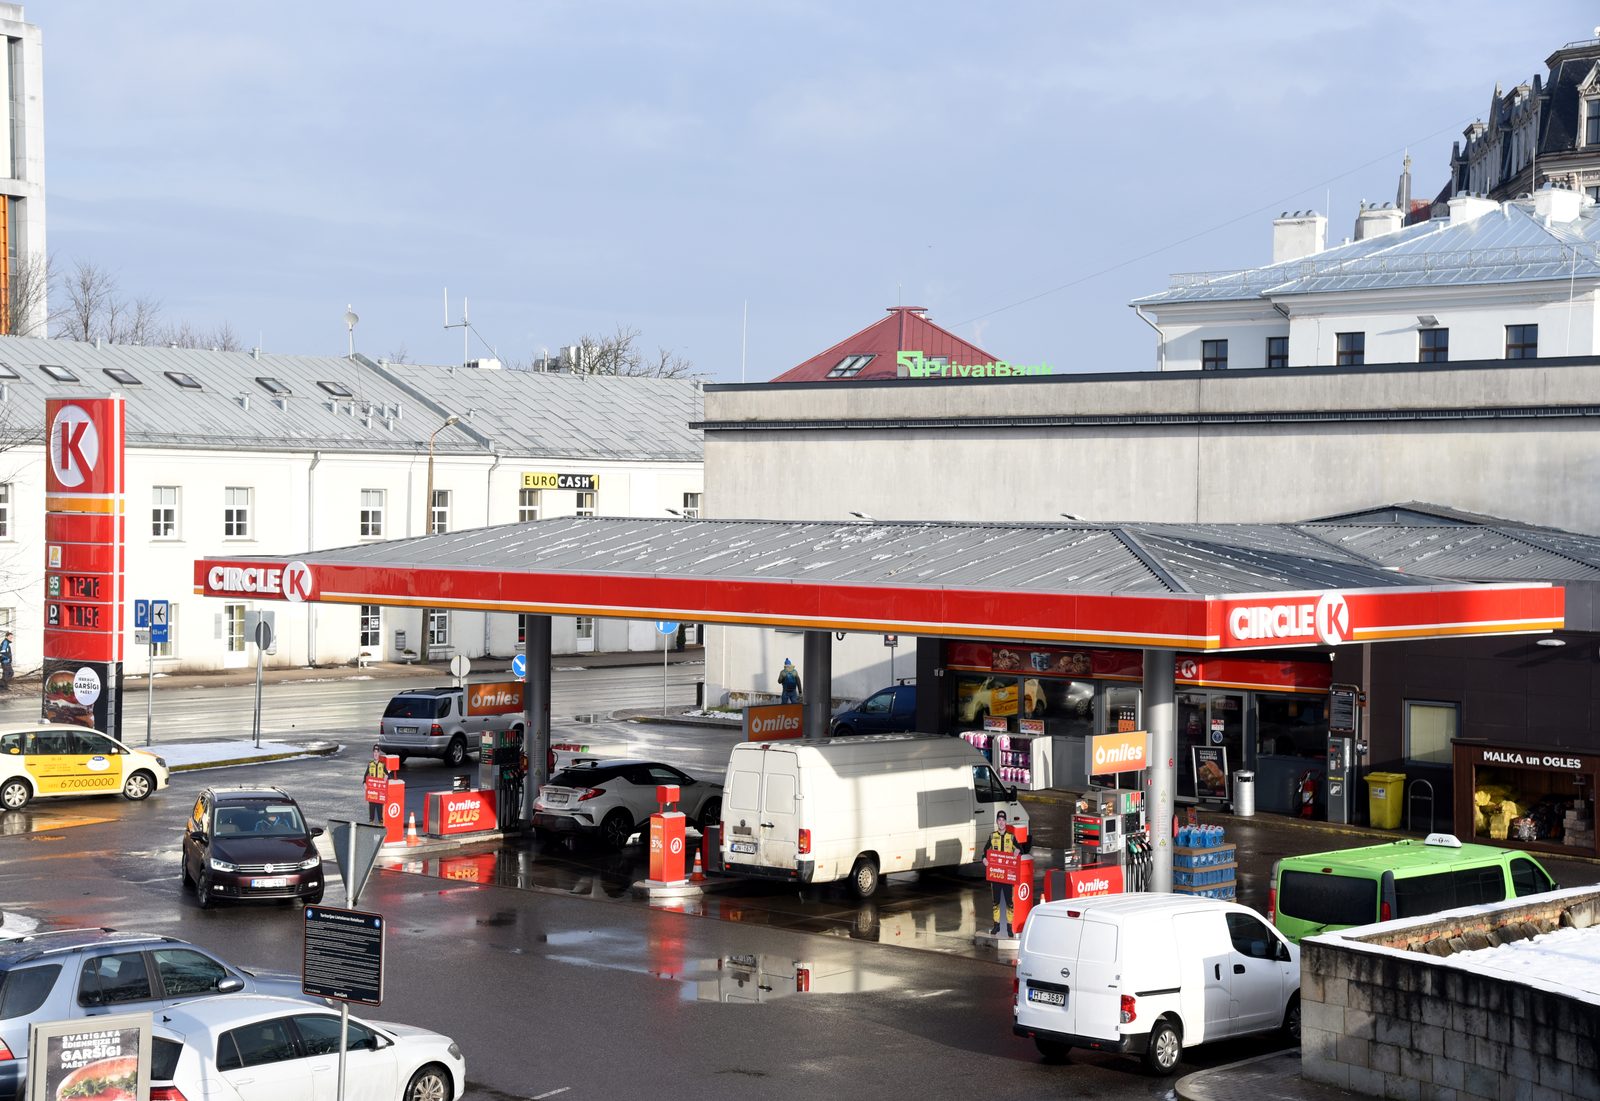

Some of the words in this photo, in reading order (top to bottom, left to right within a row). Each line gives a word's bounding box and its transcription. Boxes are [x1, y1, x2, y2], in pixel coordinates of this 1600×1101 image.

[921, 359, 1053, 377] PrivatBank
[60, 420, 94, 484] K
[49, 576, 59, 589] 95
[208, 566, 281, 594] CIRCLE
[289, 569, 312, 602] K
[50, 604, 58, 618] D
[137, 602, 146, 625] P
[1229, 604, 1315, 640] CIRCLE
[1326, 603, 1347, 642] K
[482, 691, 520, 707] miles
[762, 714, 800, 732] miles
[1106, 743, 1143, 763] miles
[1483, 751, 1524, 764] MALKA
[1526, 756, 1540, 766] un
[1542, 756, 1582, 769] OGLES
[455, 800, 481, 811] miles
[447, 809, 481, 824] PLUS
[651, 839, 663, 849] 3%
[1085, 878, 1109, 892] miles
[60, 1044, 121, 1062] GARŠĪGI
